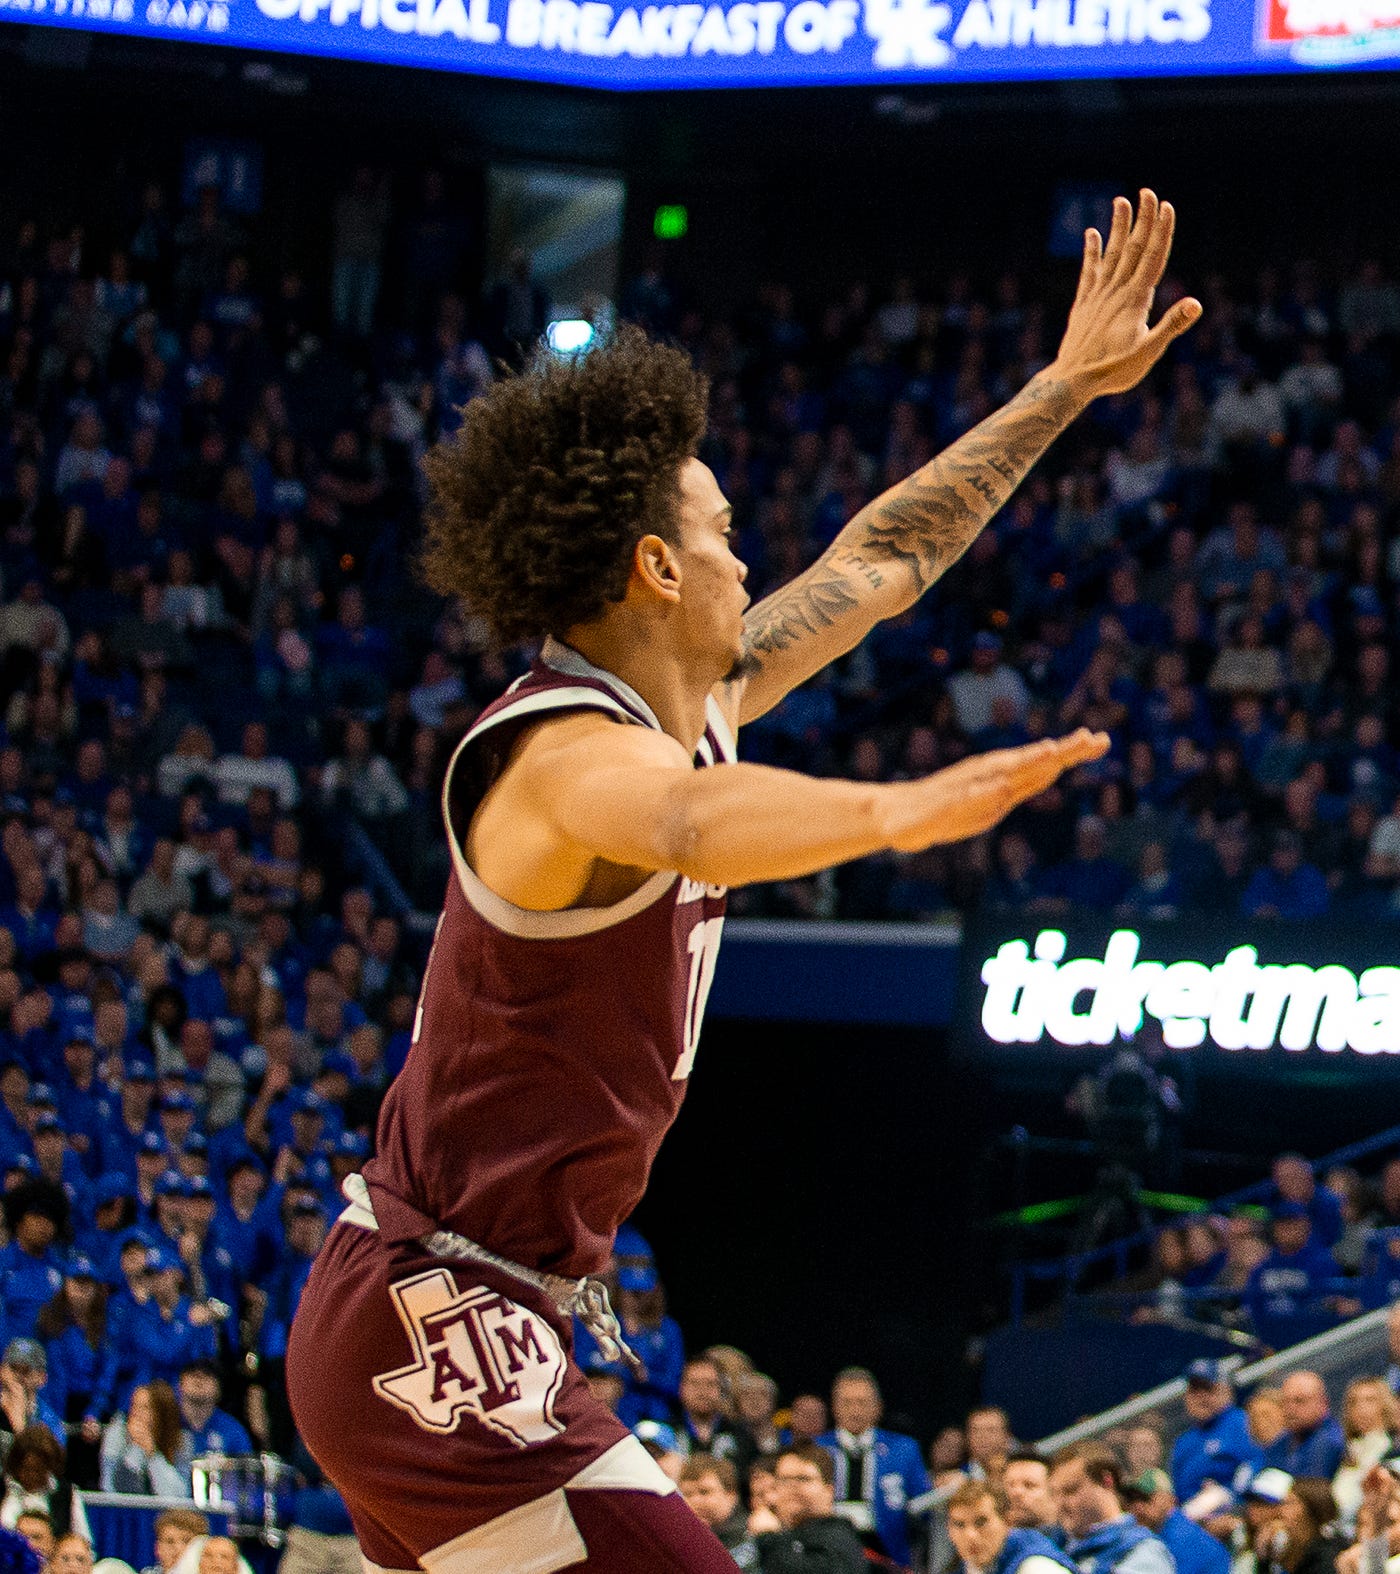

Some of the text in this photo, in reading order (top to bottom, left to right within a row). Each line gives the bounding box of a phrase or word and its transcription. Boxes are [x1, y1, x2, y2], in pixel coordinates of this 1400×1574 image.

[506, 0, 784, 58] BREAKFAST
[784, 0, 860, 55] OF
[953, 0, 1212, 48] ATHLETICS
